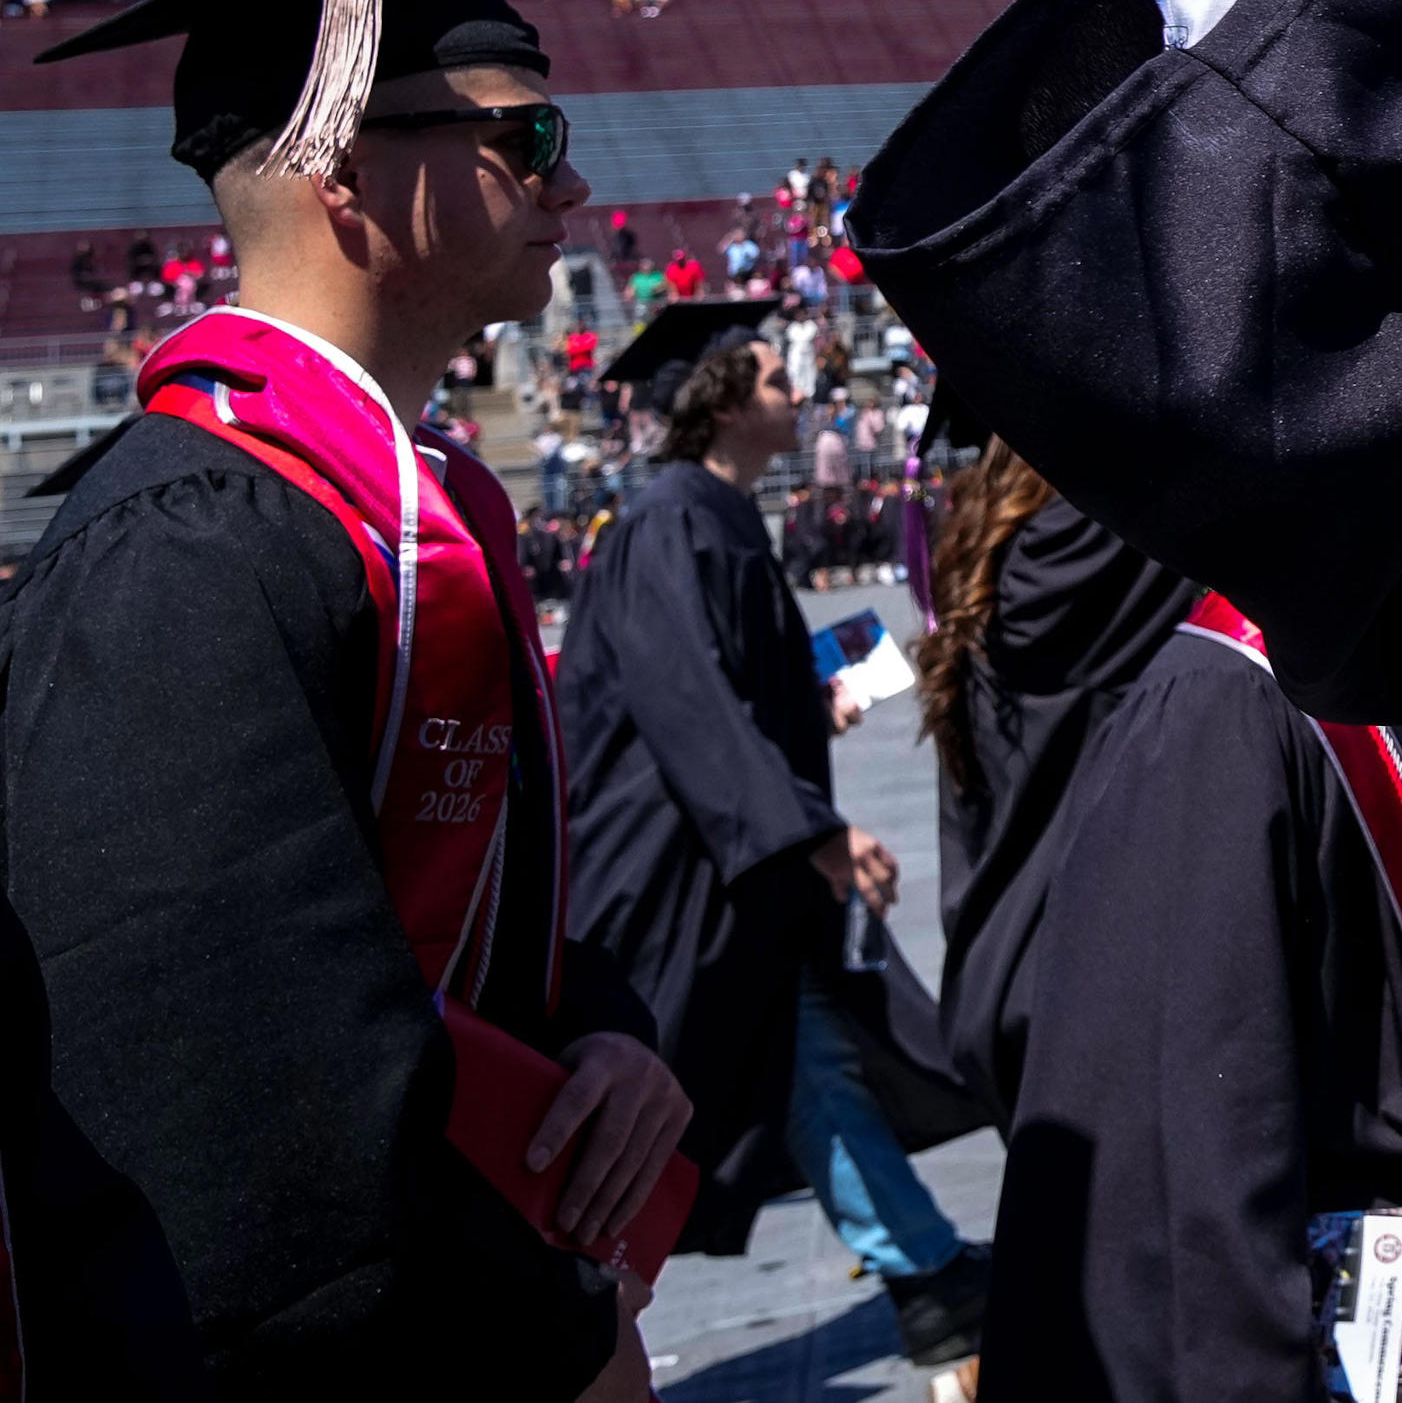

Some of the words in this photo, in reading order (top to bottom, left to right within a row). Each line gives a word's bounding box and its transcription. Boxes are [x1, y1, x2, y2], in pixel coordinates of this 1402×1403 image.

[418, 717, 513, 754] CLASS
[444, 758, 485, 789] OF
[415, 790, 488, 823] 2026
